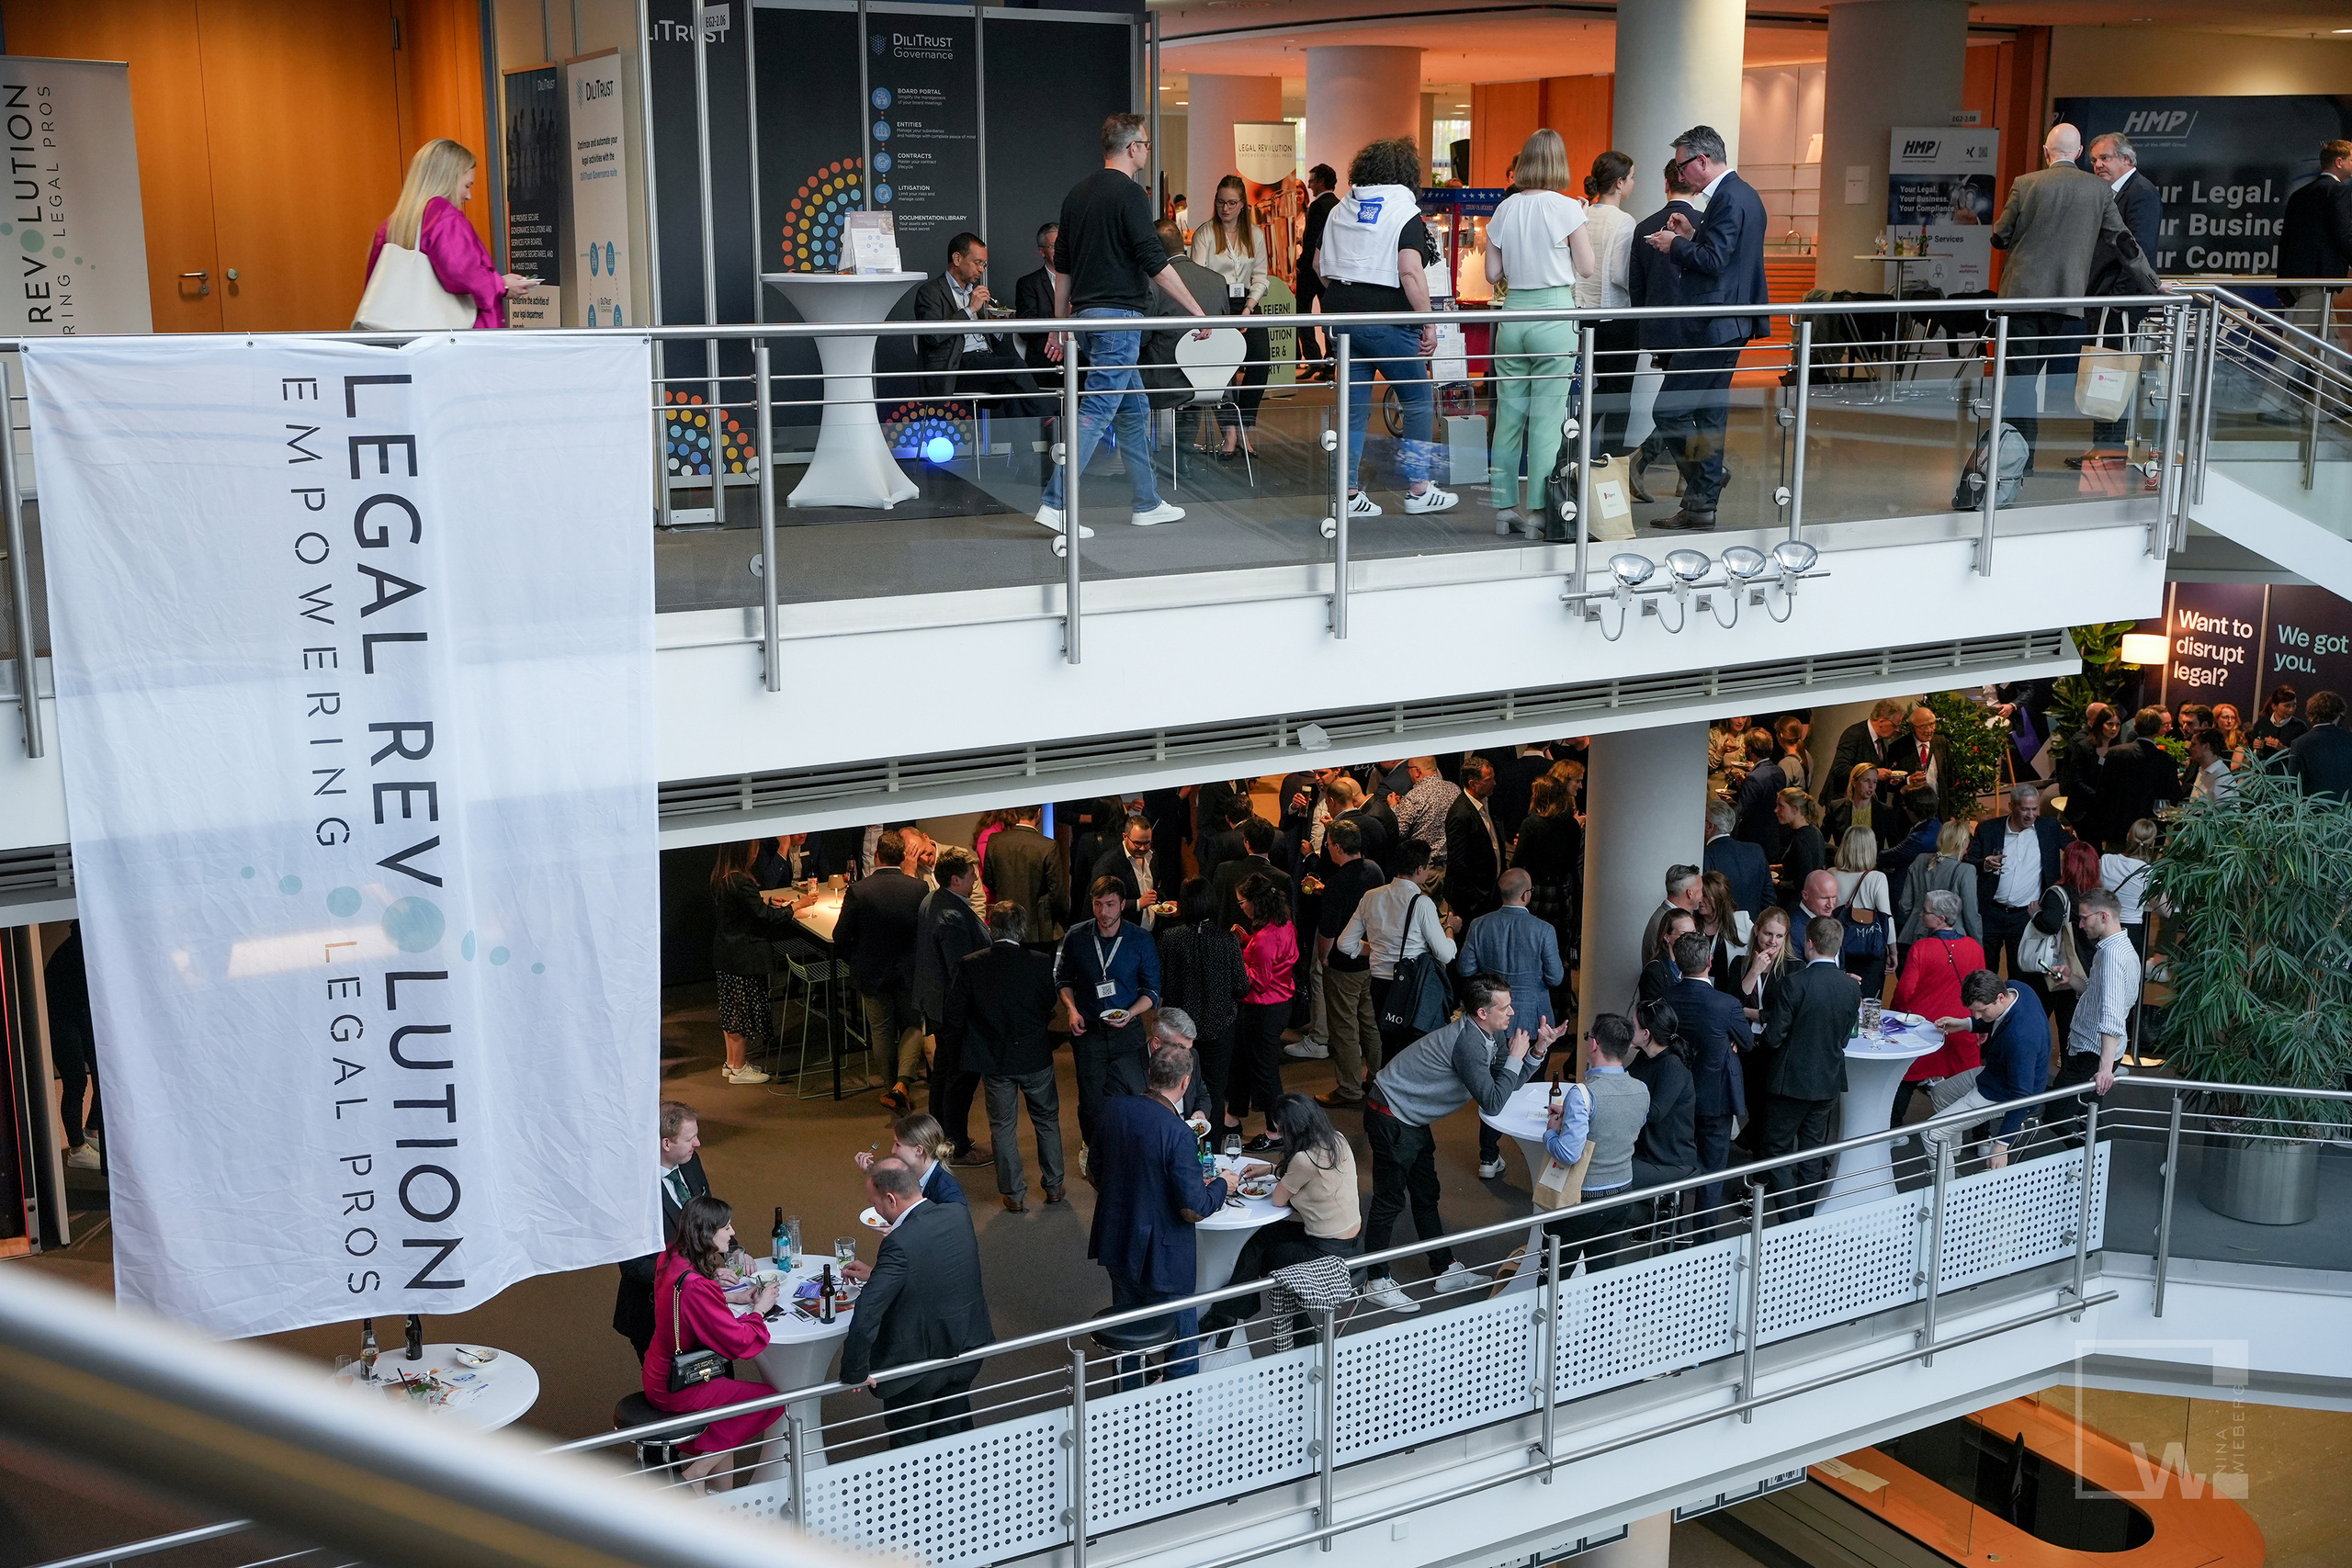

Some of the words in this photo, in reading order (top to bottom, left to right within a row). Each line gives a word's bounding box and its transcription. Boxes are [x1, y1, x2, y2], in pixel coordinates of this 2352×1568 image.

[706, 15, 727, 28] EG2-2.06
[894, 47, 954, 60] Governance
[37, 86, 56, 147] PROS
[2122, 110, 2188, 133] HMP
[1903, 141, 1936, 155] HMP
[46, 163, 66, 237] LEGAL
[1899, 195, 1916, 203] Your
[1917, 195, 1949, 203] Business.
[1917, 186, 1938, 195] Legal.
[2192, 179, 2279, 209] Legal.
[1899, 204, 1915, 212] Your
[2188, 213, 2284, 236] Busine
[2186, 244, 2278, 274] Compl
[57, 275, 75, 334] RING
[1263, 302, 1291, 314] FEIERN!
[1269, 329, 1292, 341] UTION
[1268, 364, 1281, 375] RTY
[345, 374, 428, 674] LEGAL
[282, 378, 351, 847] EMPOWERING
[2178, 609, 2229, 636] Want
[2232, 618, 2254, 639] to
[2176, 636, 2245, 666] disrupt
[2278, 624, 2310, 648] We
[2313, 635, 2349, 656] got
[2173, 660, 2229, 688] legal?
[2274, 652, 2317, 674] you.
[1385, 1012, 1403, 1024] MO
[324, 942, 368, 1120] LEGAL
[339, 1154, 380, 1294] PROS
